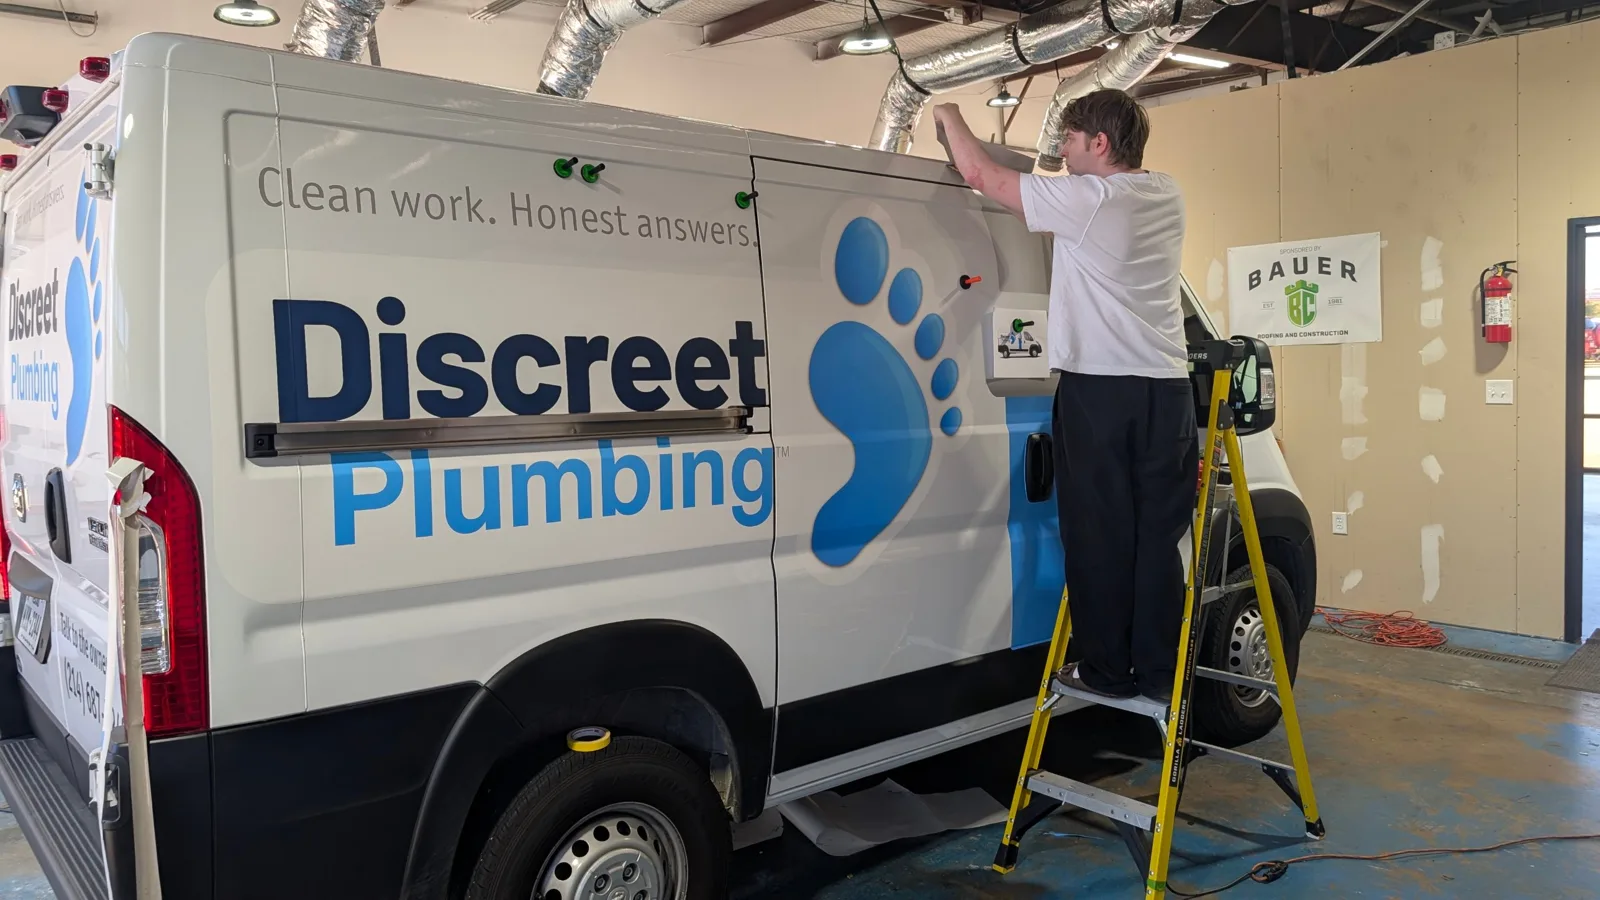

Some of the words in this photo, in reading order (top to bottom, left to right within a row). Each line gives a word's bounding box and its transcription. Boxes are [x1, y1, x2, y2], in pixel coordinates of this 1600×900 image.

[258, 167, 377, 215] Clean
[391, 186, 497, 225] work.
[510, 192, 630, 237] Honest
[637, 211, 758, 248] answers.
[1248, 256, 1357, 292] BAUER
[1279, 246, 1313, 255] SPONSORED
[8, 267, 59, 342] Discreet
[11, 350, 59, 421] Plumbing
[272, 296, 767, 424] Discreet
[1188, 352, 1208, 360] DERS
[329, 437, 775, 547] Plumbing
[60, 611, 71, 642] Talk
[72, 622, 78, 648] to
[78, 628, 89, 659] the
[64, 656, 86, 717] (214)
[1171, 748, 1180, 783] GORILLA
[1178, 698, 1187, 735] LADDERS
